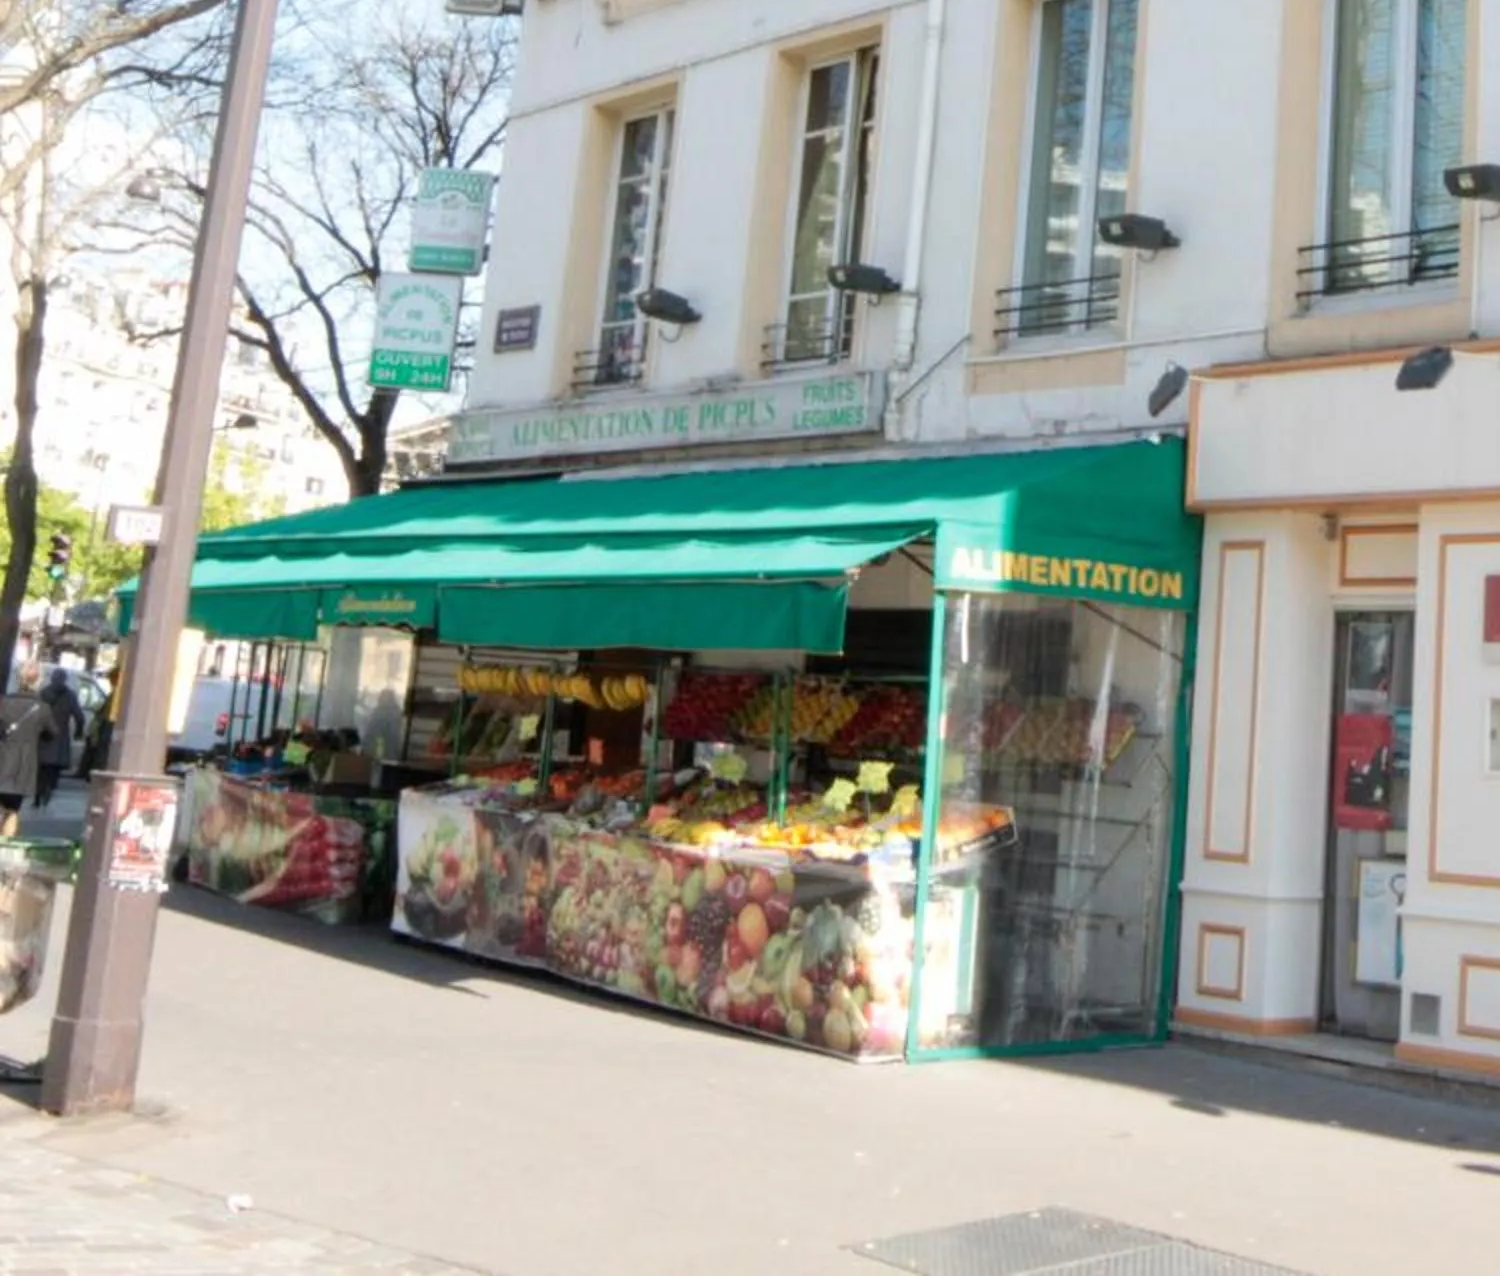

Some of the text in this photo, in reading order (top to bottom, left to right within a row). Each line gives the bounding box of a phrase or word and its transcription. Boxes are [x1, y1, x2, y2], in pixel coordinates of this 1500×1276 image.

[382, 326, 444, 344] PICPUS
[375, 350, 444, 369] OUVERT
[803, 380, 858, 406] FRUITS
[662, 403, 690, 434] DE
[950, 546, 1182, 600] ALIMENTATION
